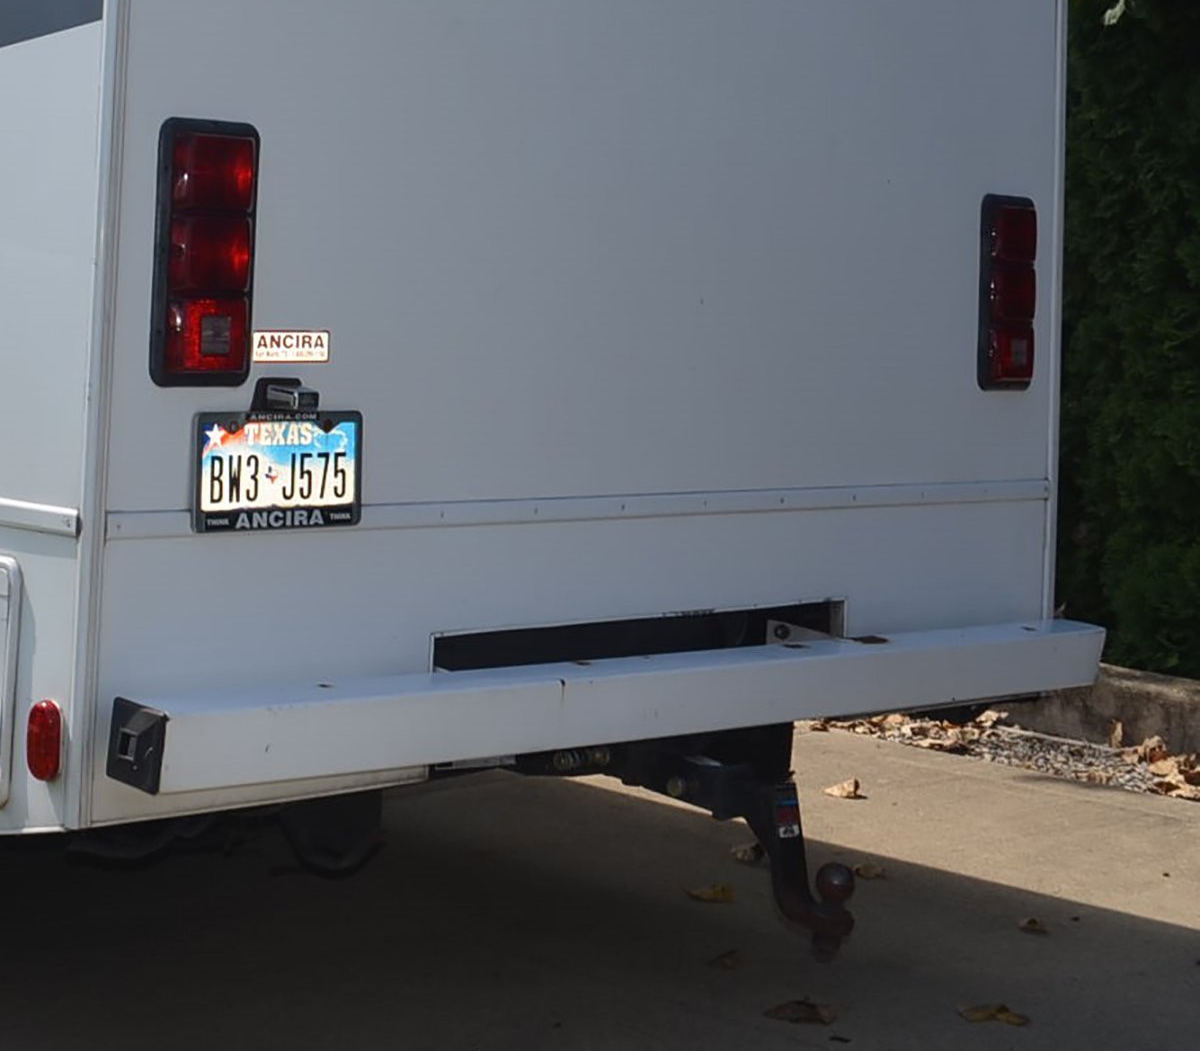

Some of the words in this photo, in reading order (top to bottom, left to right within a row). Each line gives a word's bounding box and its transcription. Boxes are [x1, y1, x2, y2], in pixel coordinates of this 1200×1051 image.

[257, 335, 324, 348] ANCIRA
[244, 421, 313, 446] TEXAS
[210, 454, 259, 504] BW3
[282, 452, 347, 501] J575
[235, 510, 325, 530] ANCIRA
